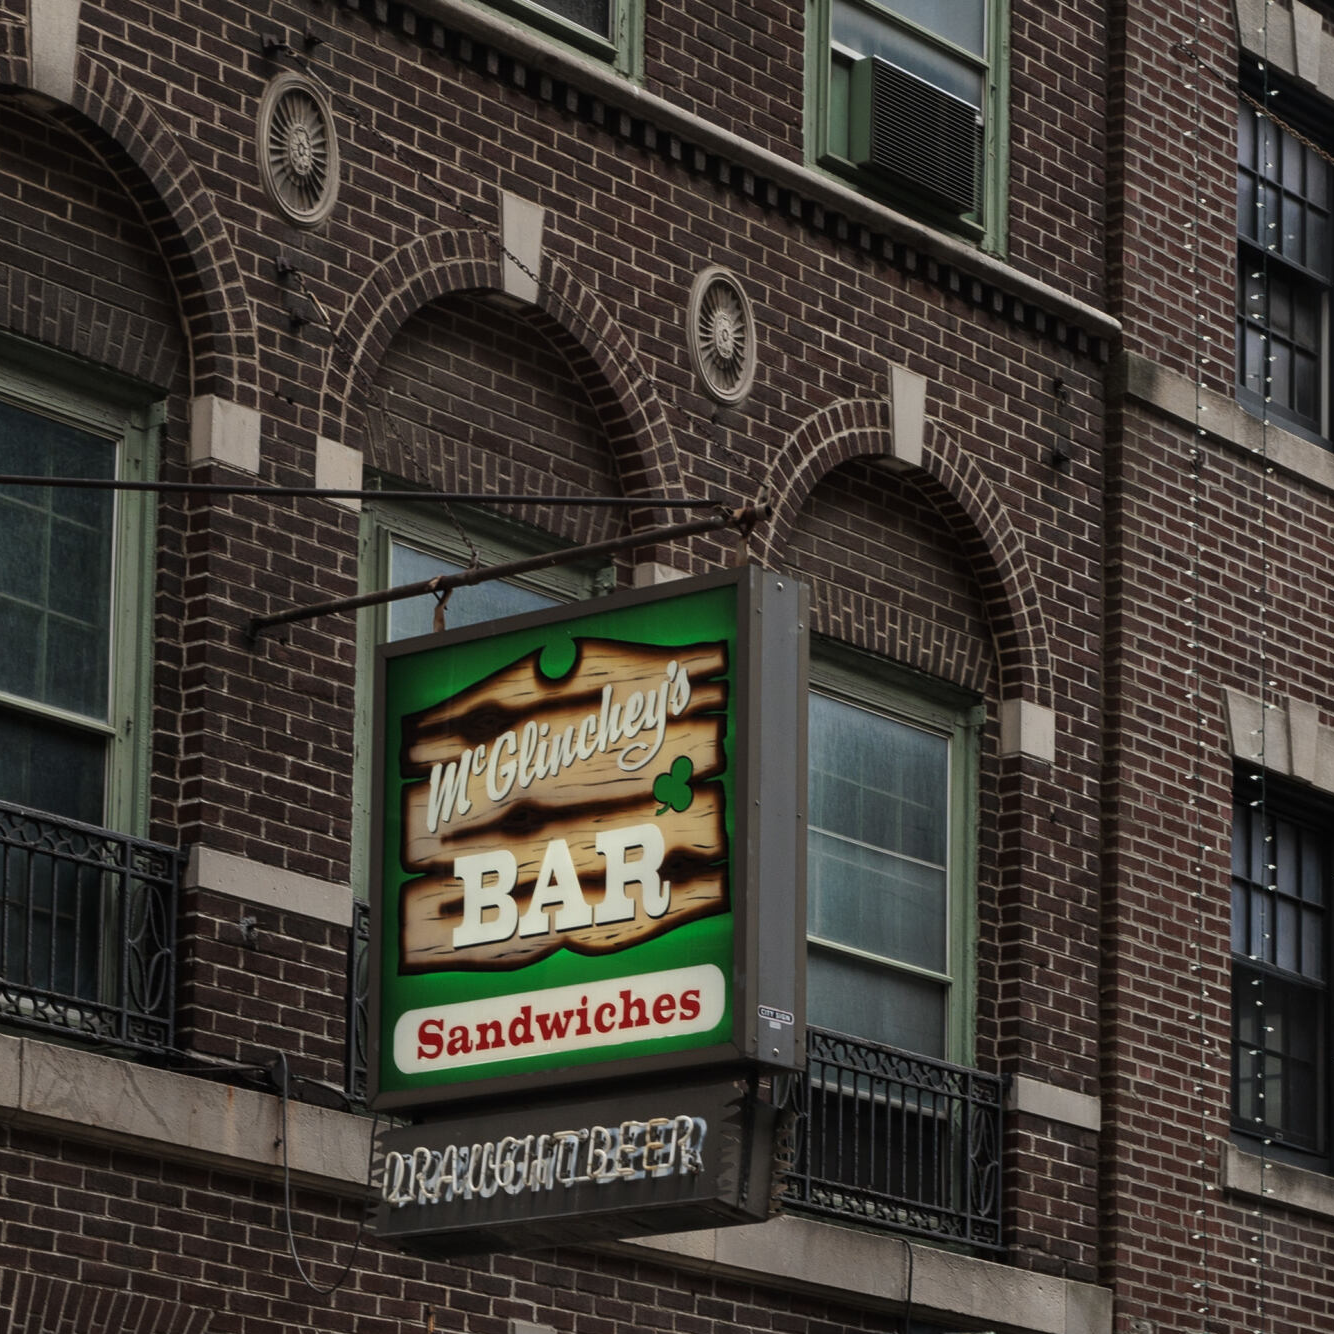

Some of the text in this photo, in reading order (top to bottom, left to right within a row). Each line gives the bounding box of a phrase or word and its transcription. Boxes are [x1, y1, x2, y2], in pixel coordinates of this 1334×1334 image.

[425, 659, 692, 833] McGlinchey's
[451, 822, 673, 949] BAR
[415, 988, 701, 1061] Sandwiches
[760, 1008, 776, 1019] CITY
[381, 1115, 708, 1208] DRAUGHT BEER
